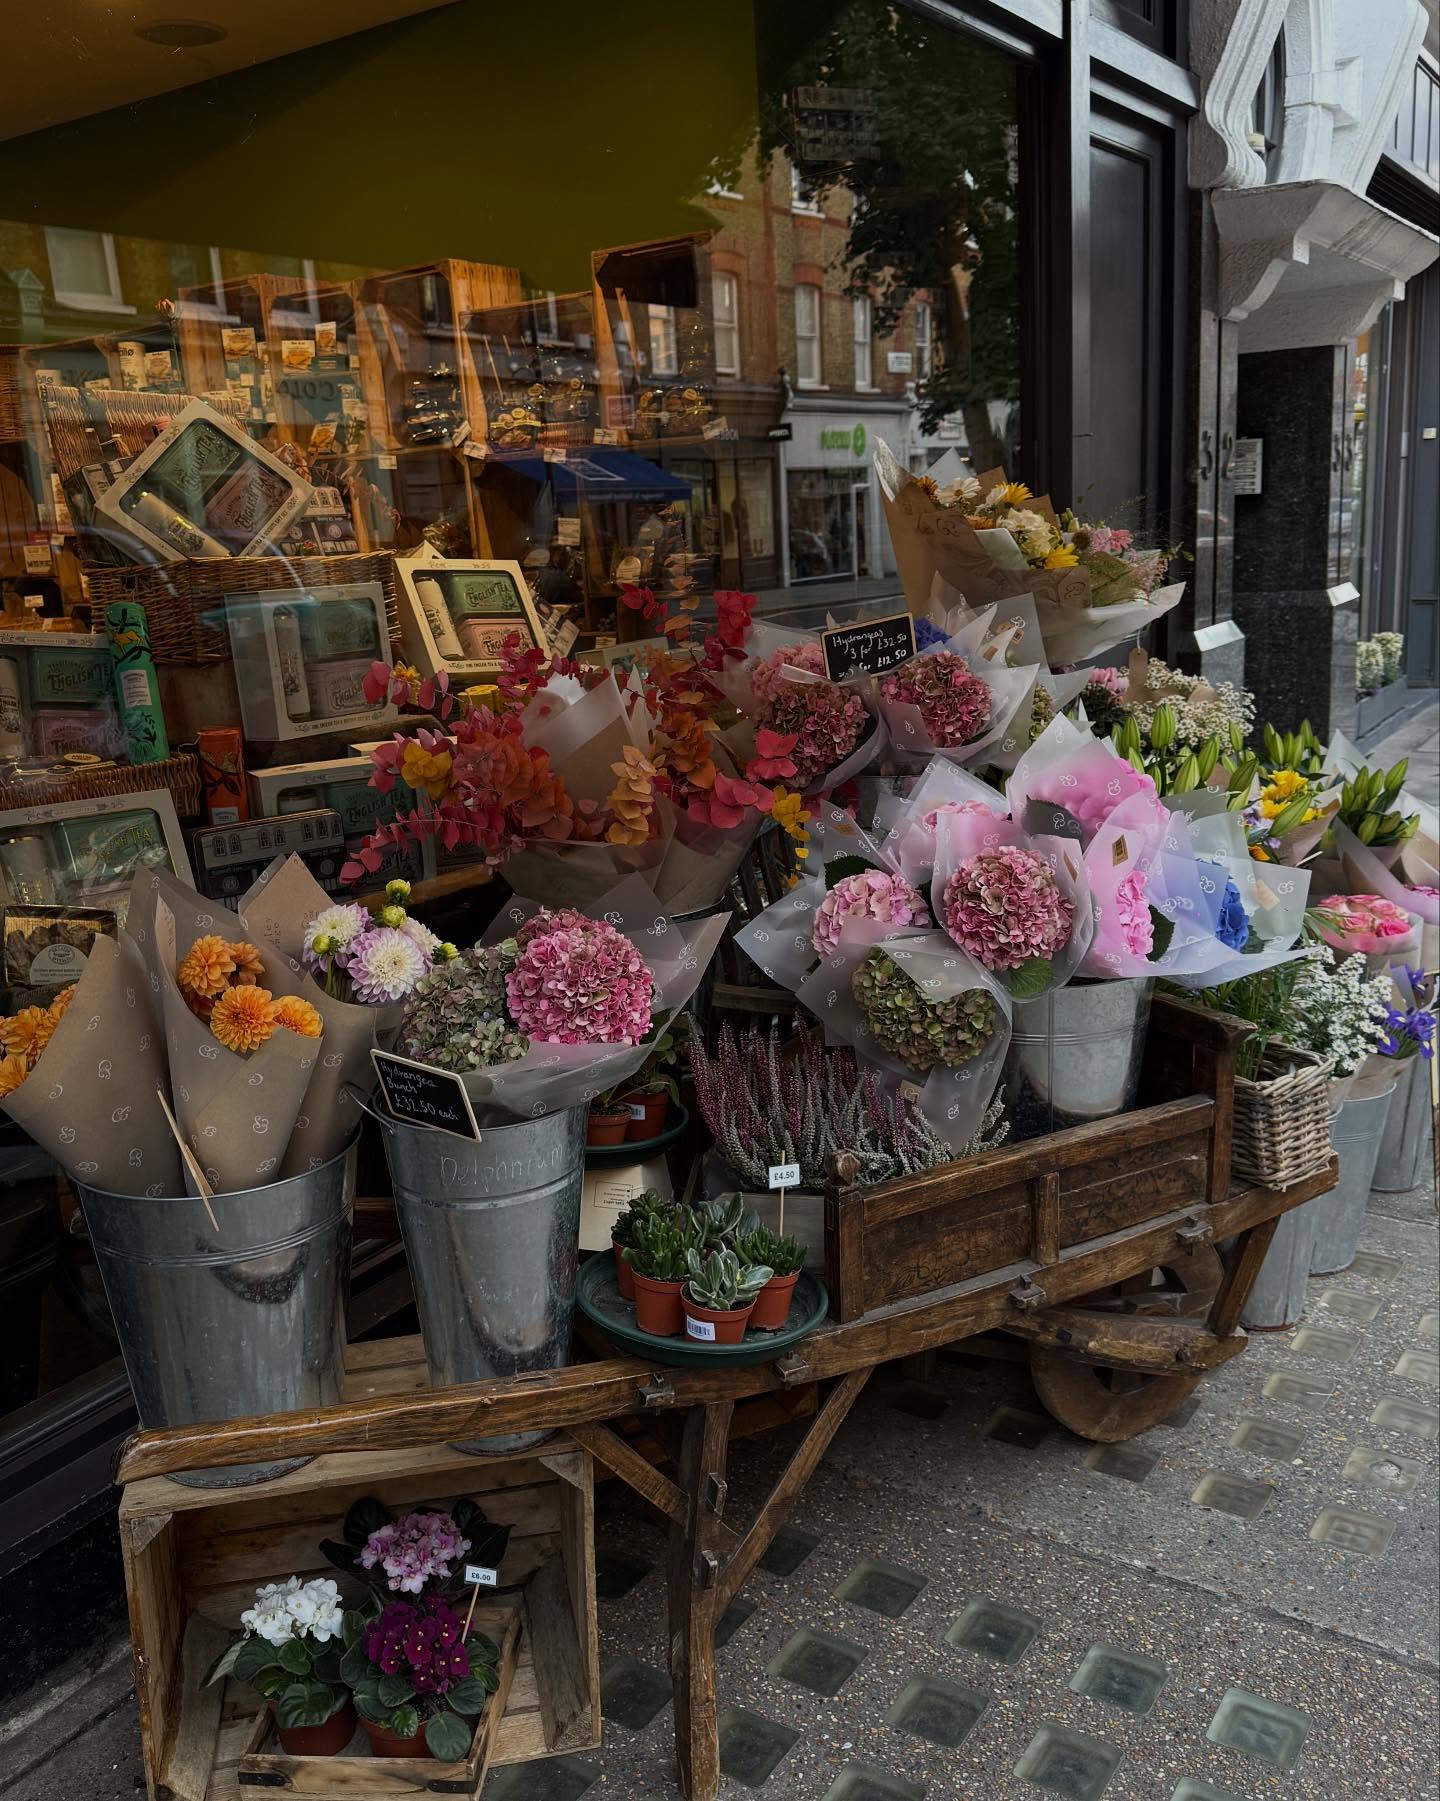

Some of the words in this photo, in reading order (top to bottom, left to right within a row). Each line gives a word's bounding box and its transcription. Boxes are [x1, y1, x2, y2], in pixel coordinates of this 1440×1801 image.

[233, 488, 260, 532] ENGLISH
[465, 586, 496, 607] ENGLISH
[494, 582, 510, 593] TEA
[832, 629, 884, 654] Hydrangeas
[850, 649, 857, 659] 3
[860, 646, 872, 659] for
[877, 649, 907, 668] £12.50
[48, 668, 93, 691] ENGLISH
[346, 799, 386, 824] ENGLISH
[129, 824, 153, 845] TEA
[380, 1060, 439, 1088] Hydrangea
[386, 1077, 418, 1094] Bunch
[438, 1106, 459, 1121] each
[774, 1170, 795, 1181] £4.50
